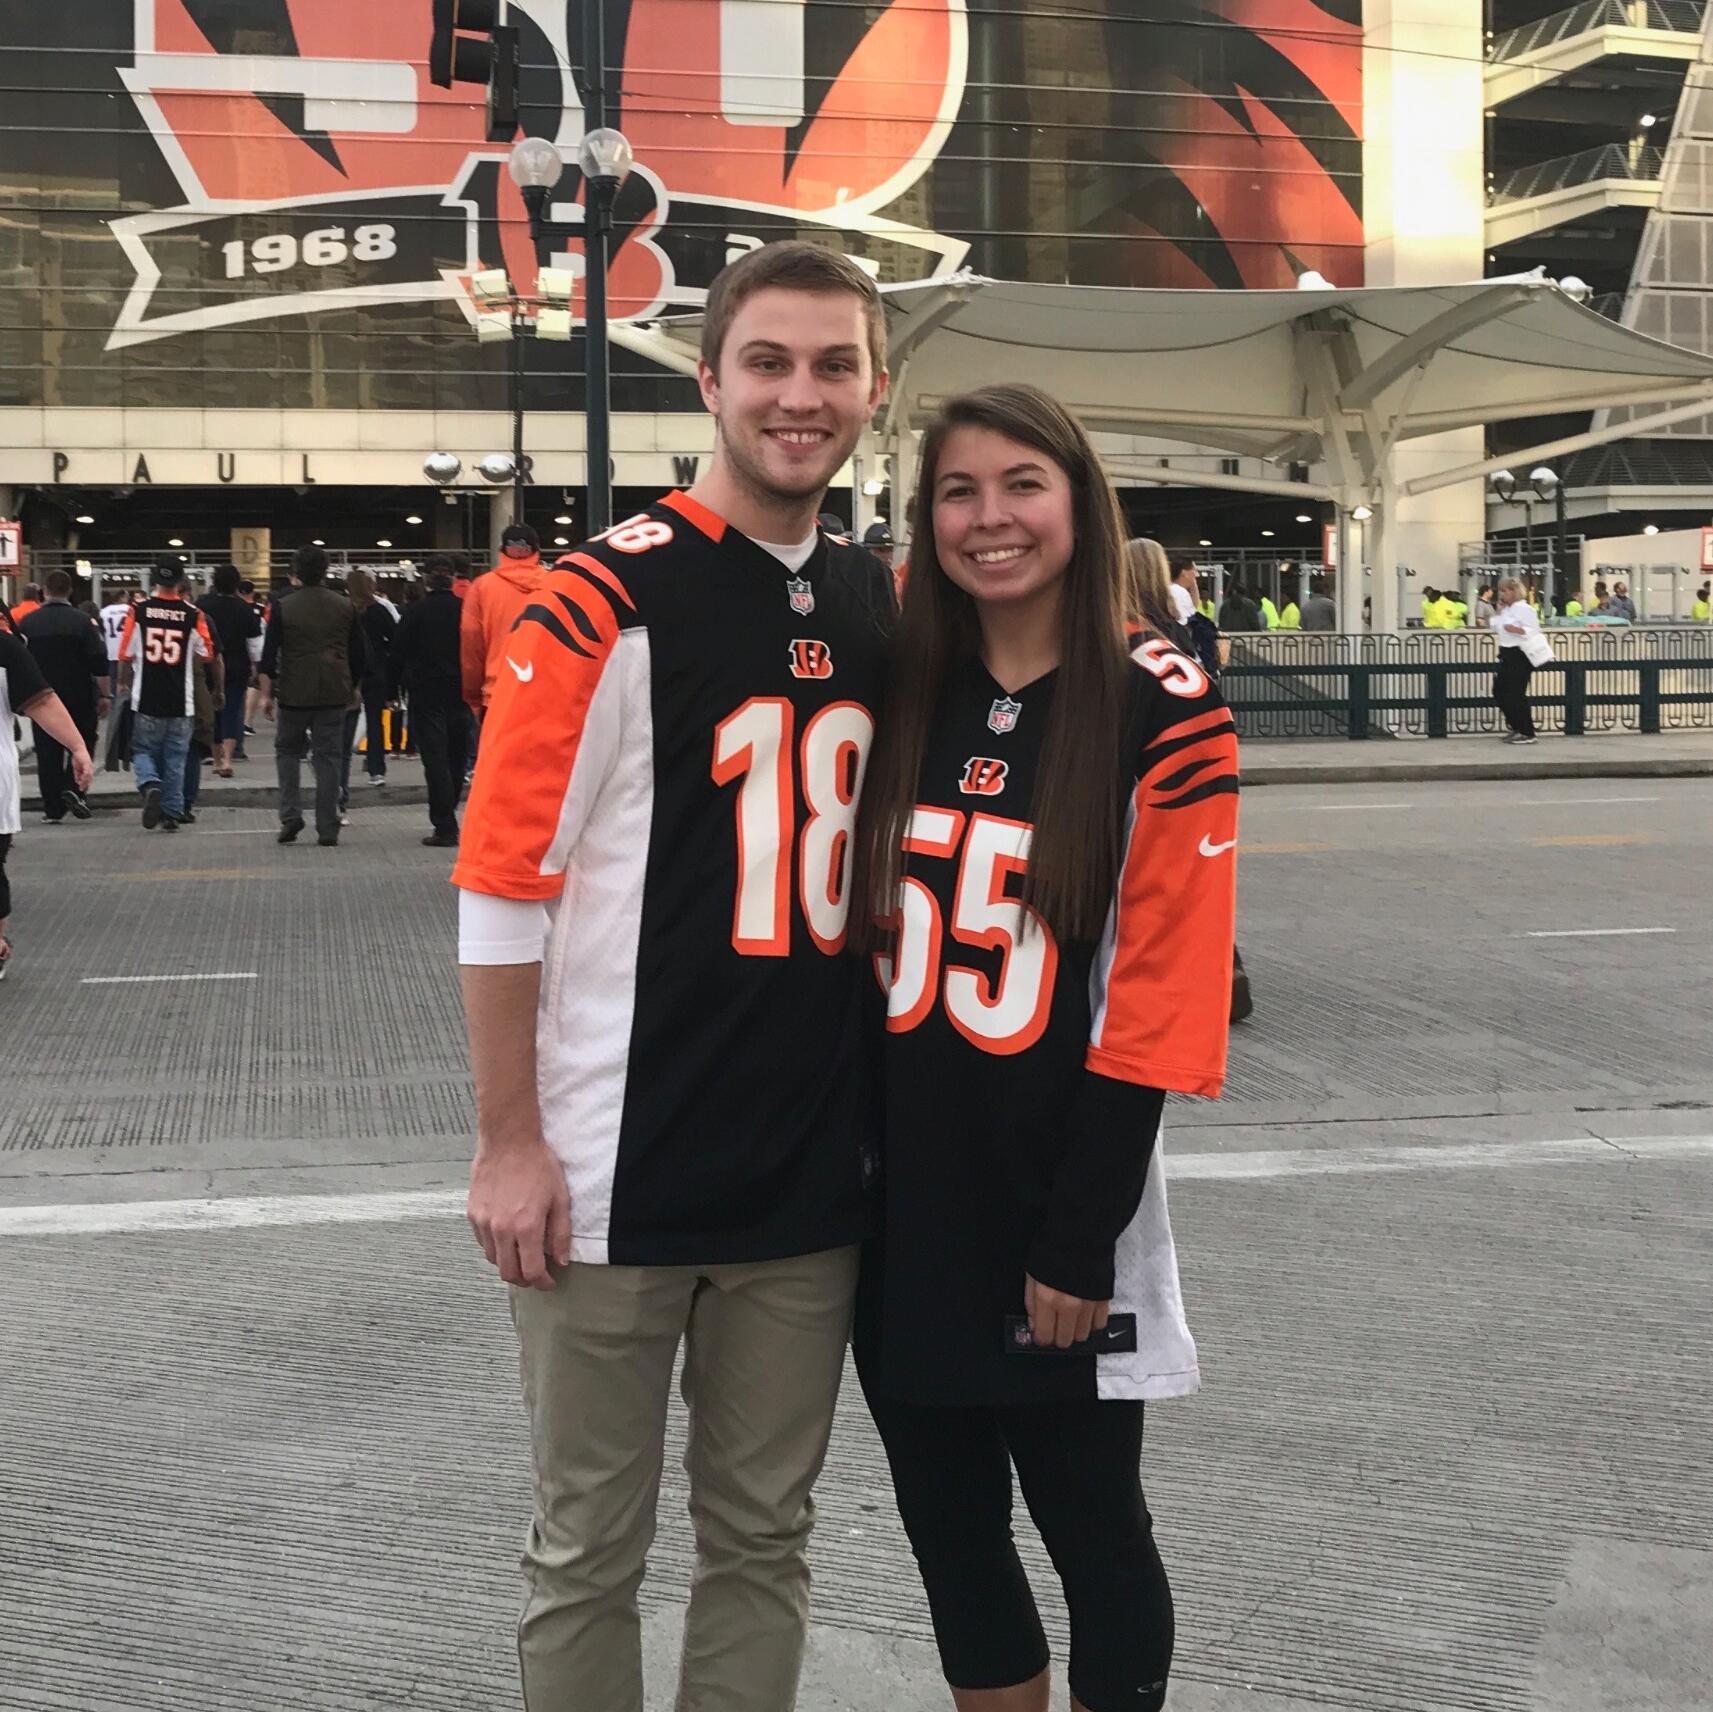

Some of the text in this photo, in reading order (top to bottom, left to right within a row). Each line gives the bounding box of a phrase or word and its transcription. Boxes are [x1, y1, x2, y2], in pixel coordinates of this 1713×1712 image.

[222, 224, 397, 279] 1968
[145, 626, 183, 665] 55
[711, 697, 875, 957] 18
[872, 803, 1059, 1056] 55
